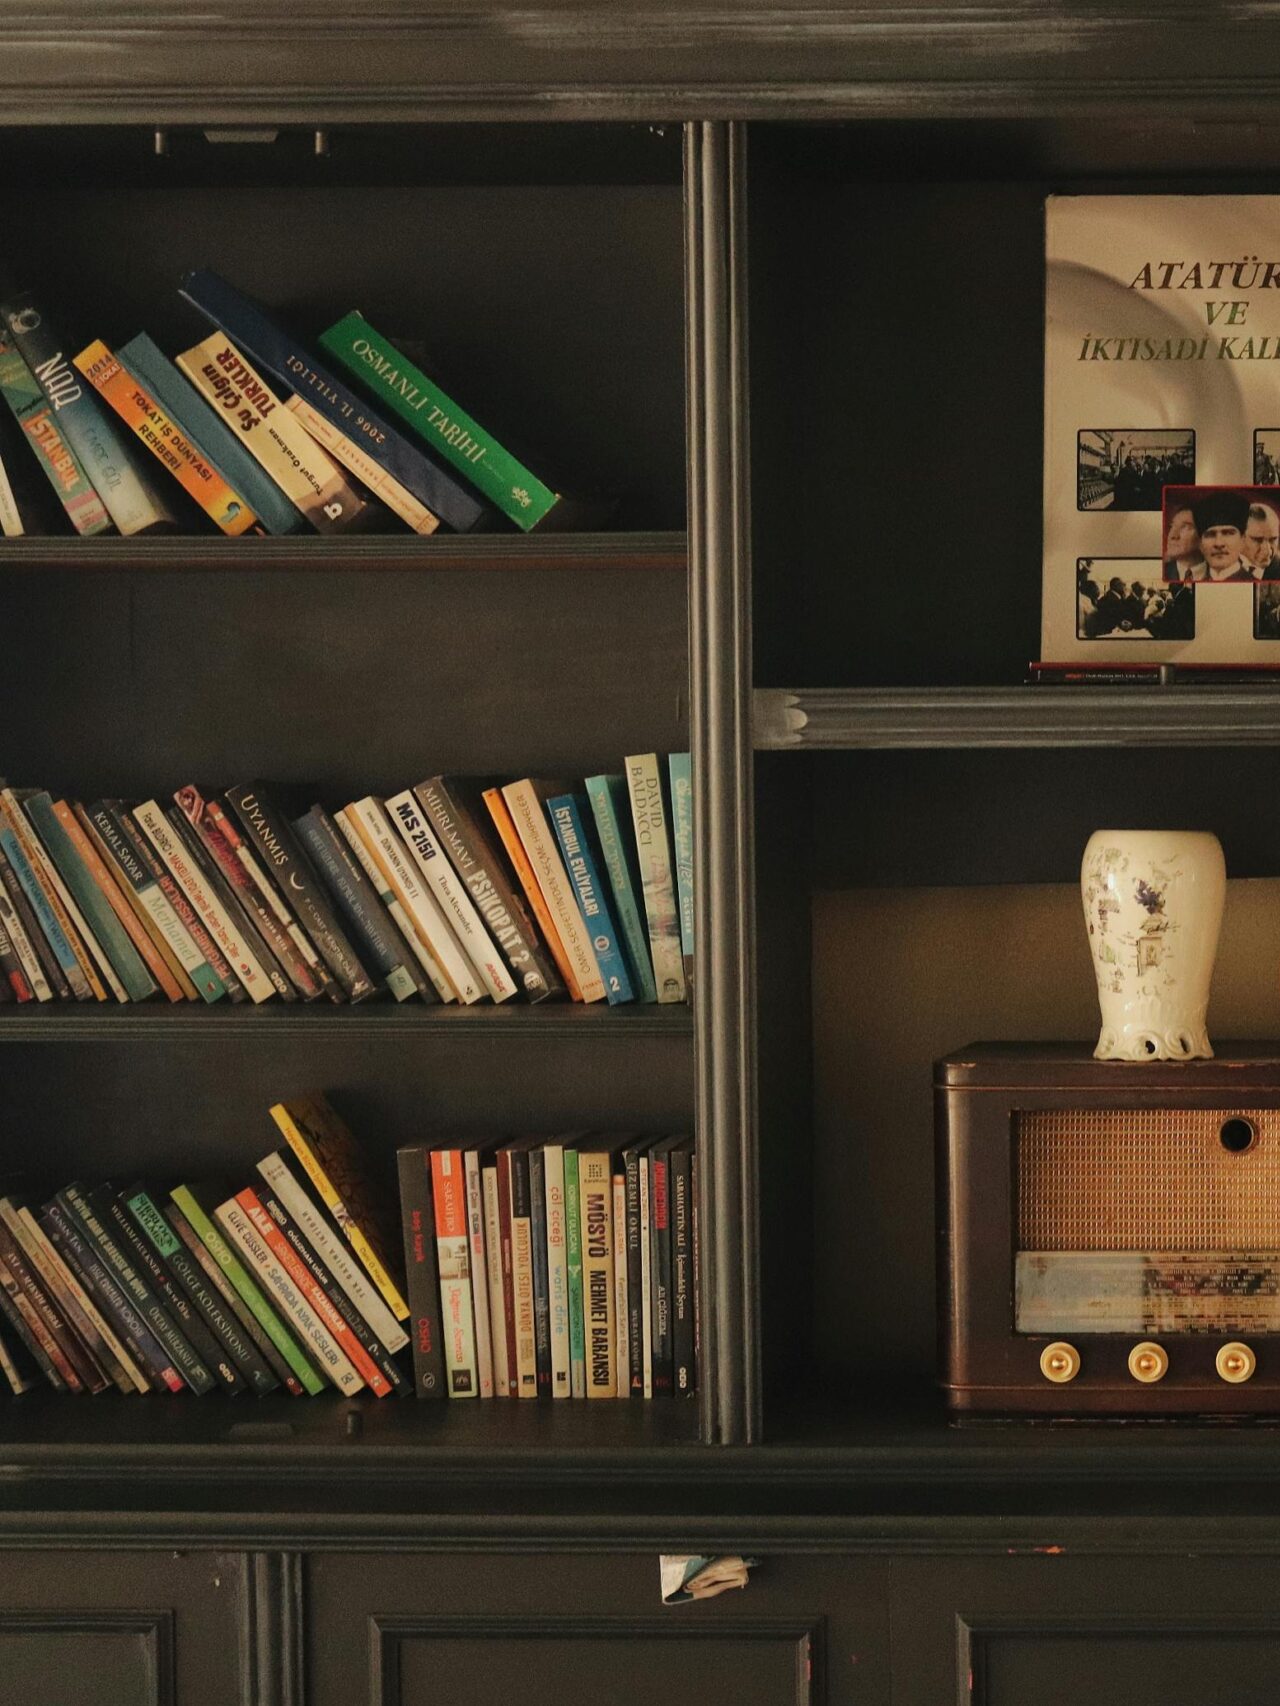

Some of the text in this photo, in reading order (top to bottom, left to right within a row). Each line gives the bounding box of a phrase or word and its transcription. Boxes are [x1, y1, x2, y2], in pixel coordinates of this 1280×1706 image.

[1204, 301, 1249, 326] VE
[31, 350, 85, 411] NAR
[87, 355, 112, 378] 2014
[197, 360, 261, 433] Şu Çılgın
[348, 335, 428, 411] OSMANLI
[421, 402, 486, 465] TARİHİ
[20, 406, 87, 496] İSTANBUL
[129, 390, 212, 484] TOKAT İŞ DÜNYASI
[137, 420, 183, 472] REHBERİ
[353, 414, 387, 445] 2006
[298, 465, 324, 495] Turgut
[629, 766, 651, 845] BALDACCI
[645, 778, 662, 828] DAVID
[94, 811, 123, 849] KEMAL
[117, 846, 144, 881] SAYAR
[395, 801, 437, 861] MS 2150
[553, 805, 601, 917] İSTANBUL EVLİYALARI
[147, 894, 196, 963] Merhamet
[437, 875, 475, 935] Thea Alexander
[507, 949, 530, 968] 2
[607, 975, 621, 992] 2
[109, 1203, 138, 1240] WILLIAM
[134, 1204, 168, 1248] HOLMES
[135, 1193, 177, 1248] SHERLOCK
[567, 1184, 578, 1253] KORKUT ULUCAN
[585, 1193, 608, 1257] MÖSYÖ
[628, 1217, 637, 1249] OKUL
[204, 1230, 233, 1266] OSHO
[285, 1228, 330, 1285] OĞUZHAN UĞUR
[516, 1222, 529, 1268] YOLCULUK
[227, 1210, 247, 1232] CLIVE
[294, 1306, 317, 1332] AYAK
[351, 1280, 366, 1298] TEK
[517, 1272, 530, 1297] ÖTESİ
[553, 1265, 565, 1300] waris
[418, 1317, 432, 1352] OSHO
[518, 1301, 531, 1331] DÜNYA
[555, 1304, 567, 1333] dirie
[589, 1269, 610, 1385] MEHMET BARANSU
